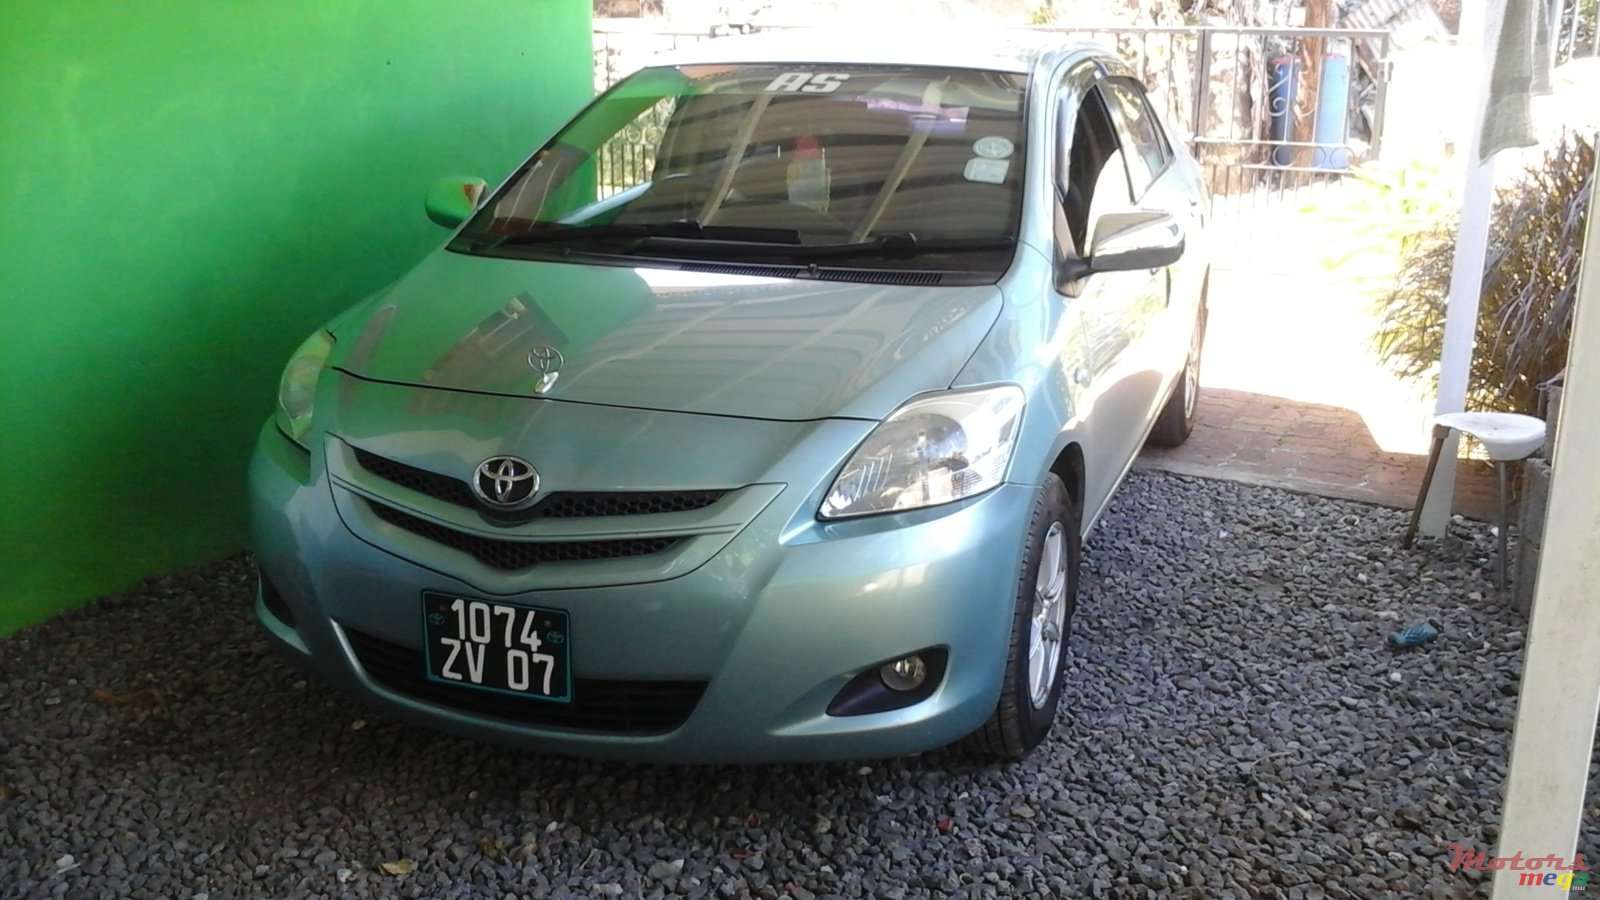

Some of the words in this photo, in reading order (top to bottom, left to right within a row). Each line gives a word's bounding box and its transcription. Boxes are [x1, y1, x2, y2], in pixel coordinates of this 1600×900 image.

[451, 599, 542, 652] 1074
[440, 637, 486, 684] ZV
[507, 649, 554, 695] 07
